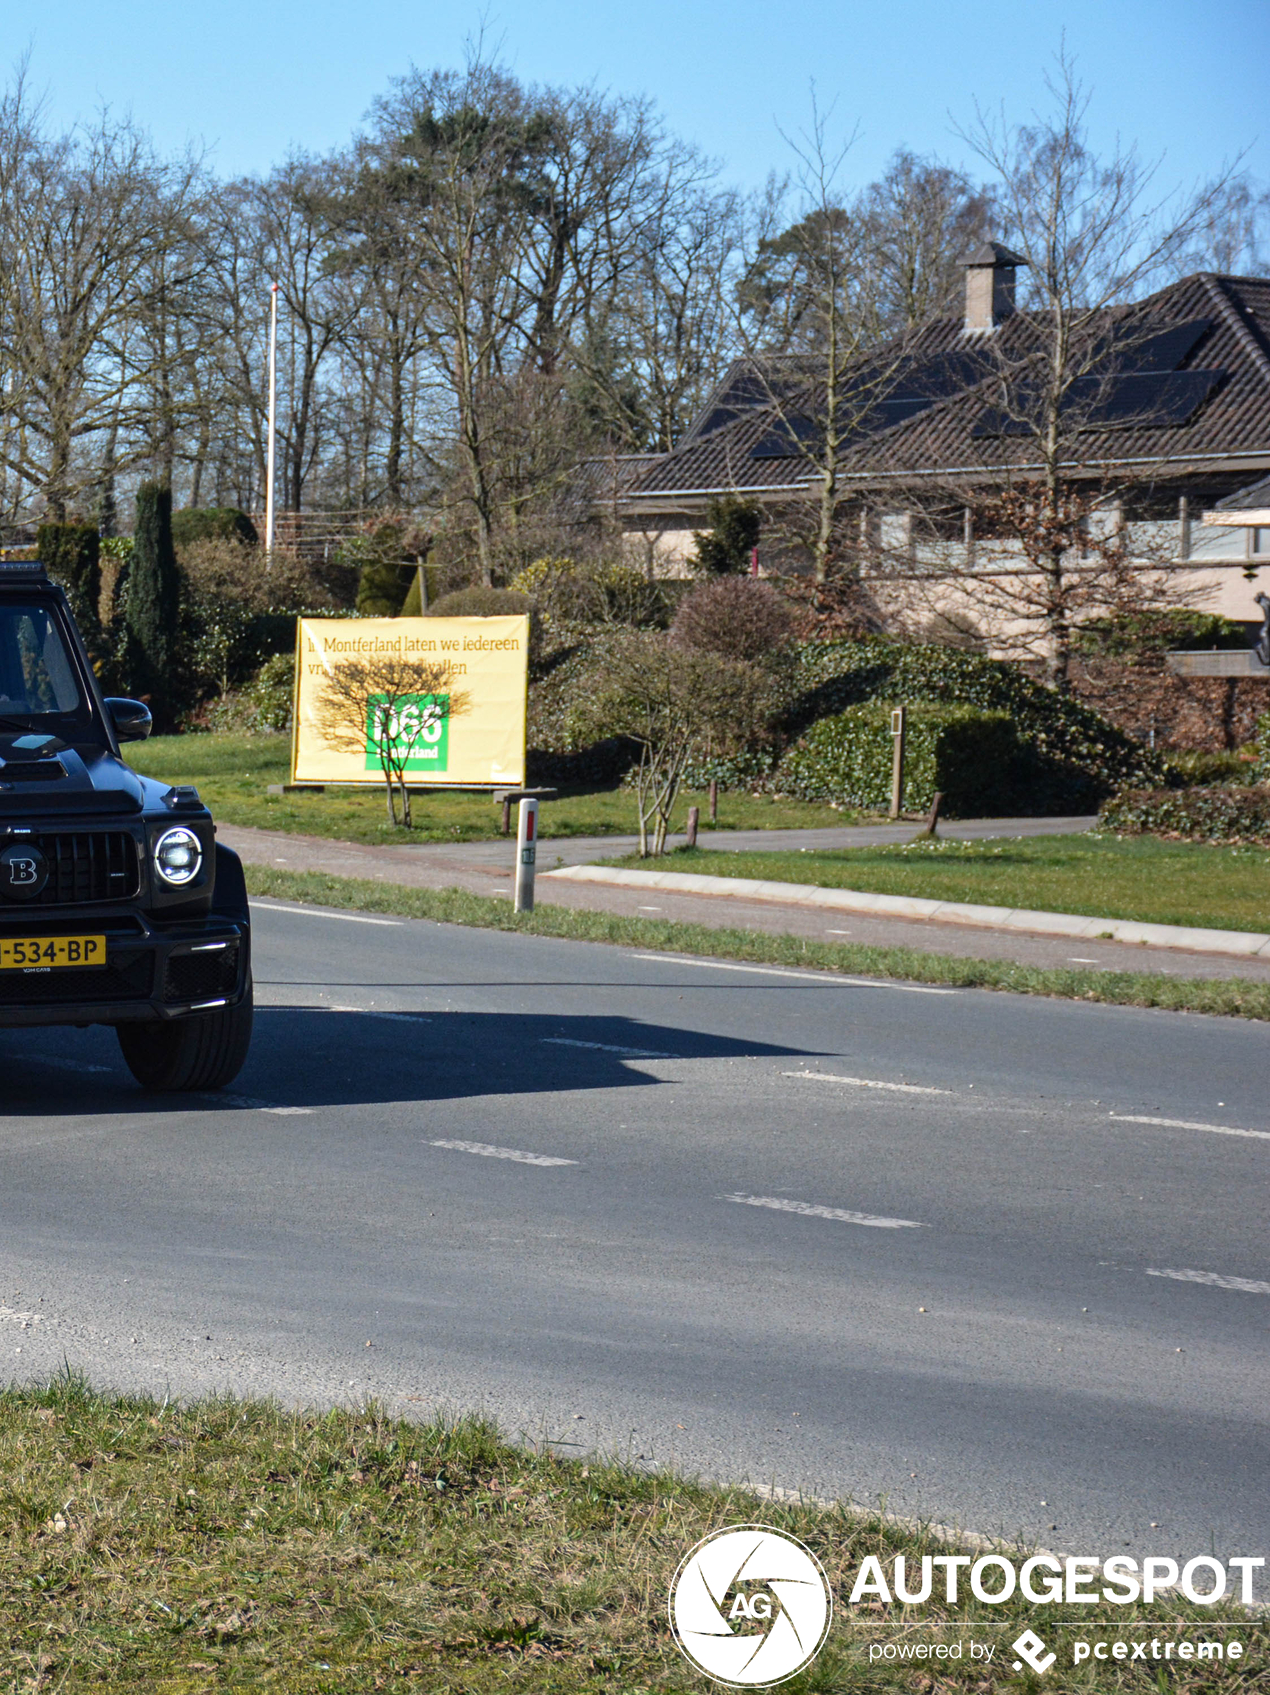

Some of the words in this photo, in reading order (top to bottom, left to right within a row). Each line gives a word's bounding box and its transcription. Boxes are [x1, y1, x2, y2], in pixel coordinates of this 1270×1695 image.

[324, 635, 401, 652] Montferland
[404, 635, 437, 652] laten
[440, 639, 460, 651] we
[463, 635, 520, 651] iedereen
[10, 858, 38, 884] B
